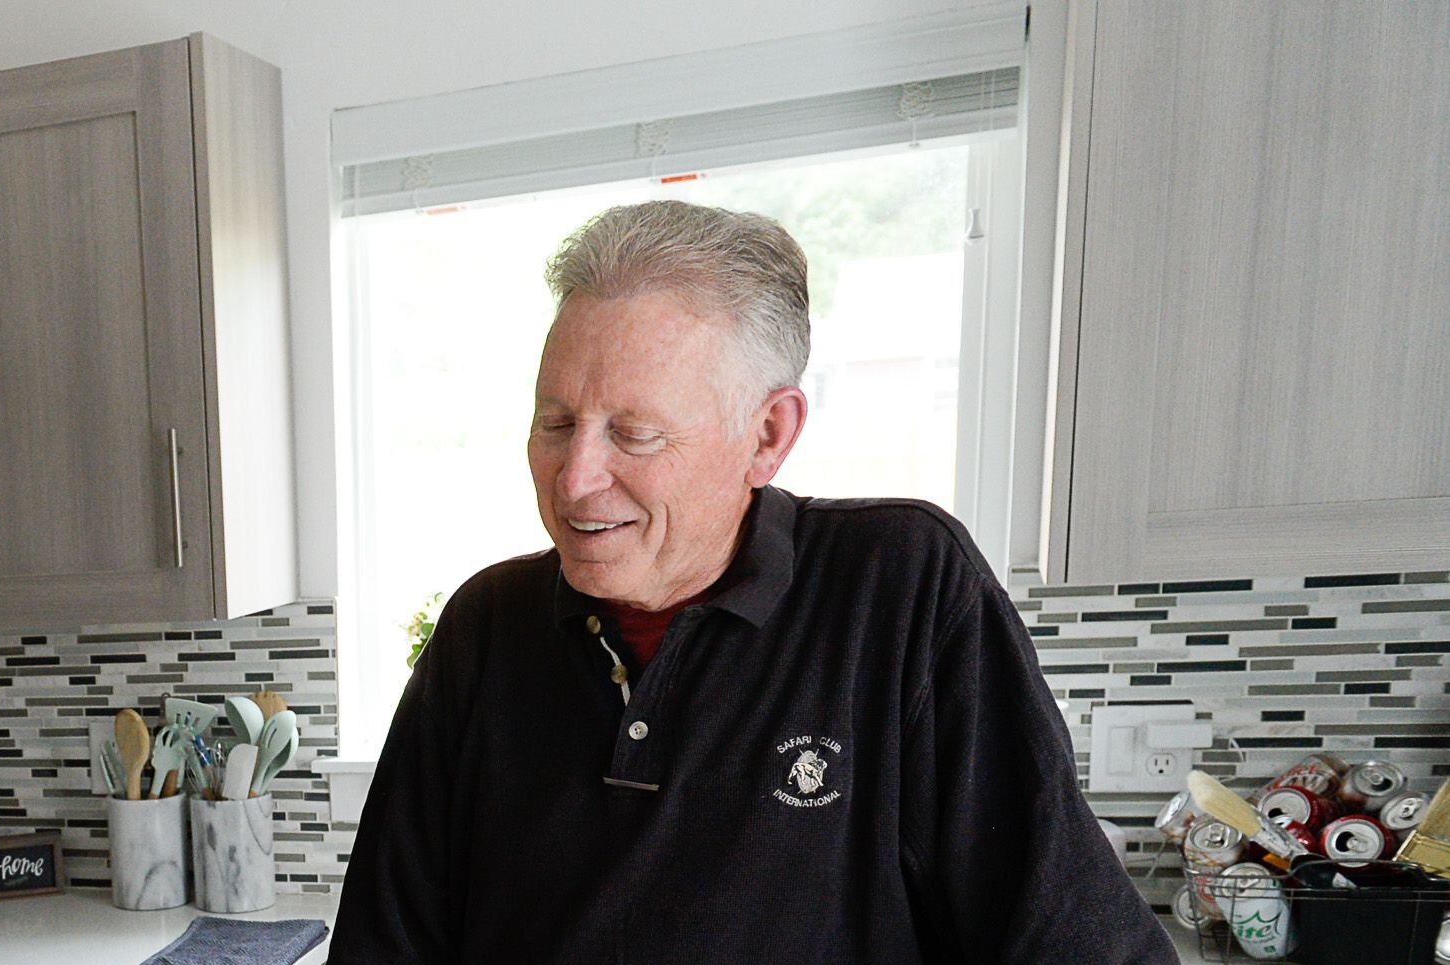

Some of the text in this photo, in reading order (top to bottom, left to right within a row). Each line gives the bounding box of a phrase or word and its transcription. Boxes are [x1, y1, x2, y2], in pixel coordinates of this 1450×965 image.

[776, 735, 842, 754] SAFARI CLUB
[772, 788, 842, 808] INTERNATIONAL
